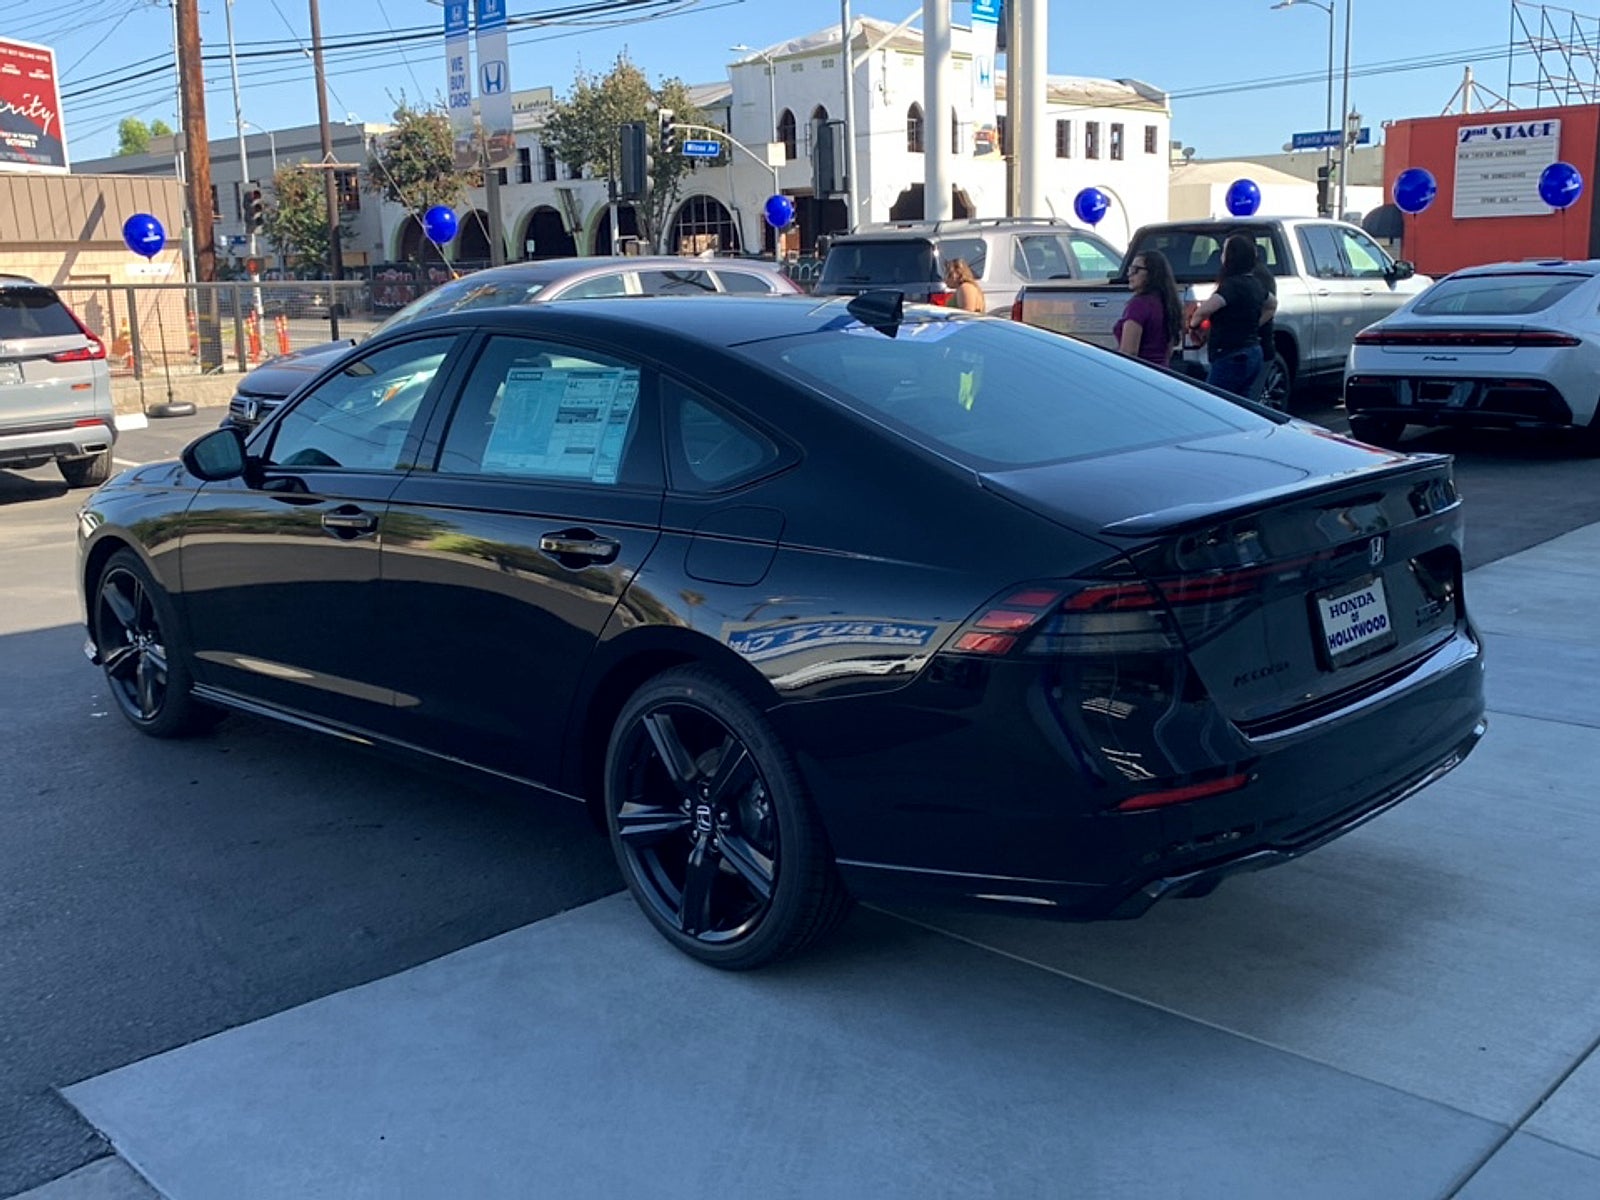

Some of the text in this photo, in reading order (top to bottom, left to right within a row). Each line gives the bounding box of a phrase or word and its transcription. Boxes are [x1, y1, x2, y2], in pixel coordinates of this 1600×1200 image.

[450, 56, 463, 72] WE
[450, 74, 466, 90] BUY
[450, 92, 470, 108] CARS!
[0, 93, 55, 136] rity
[1460, 122, 1556, 142] 2nd STAGE
[1328, 592, 1376, 618] HONDA
[1328, 614, 1386, 648] HOLLYWOOD
